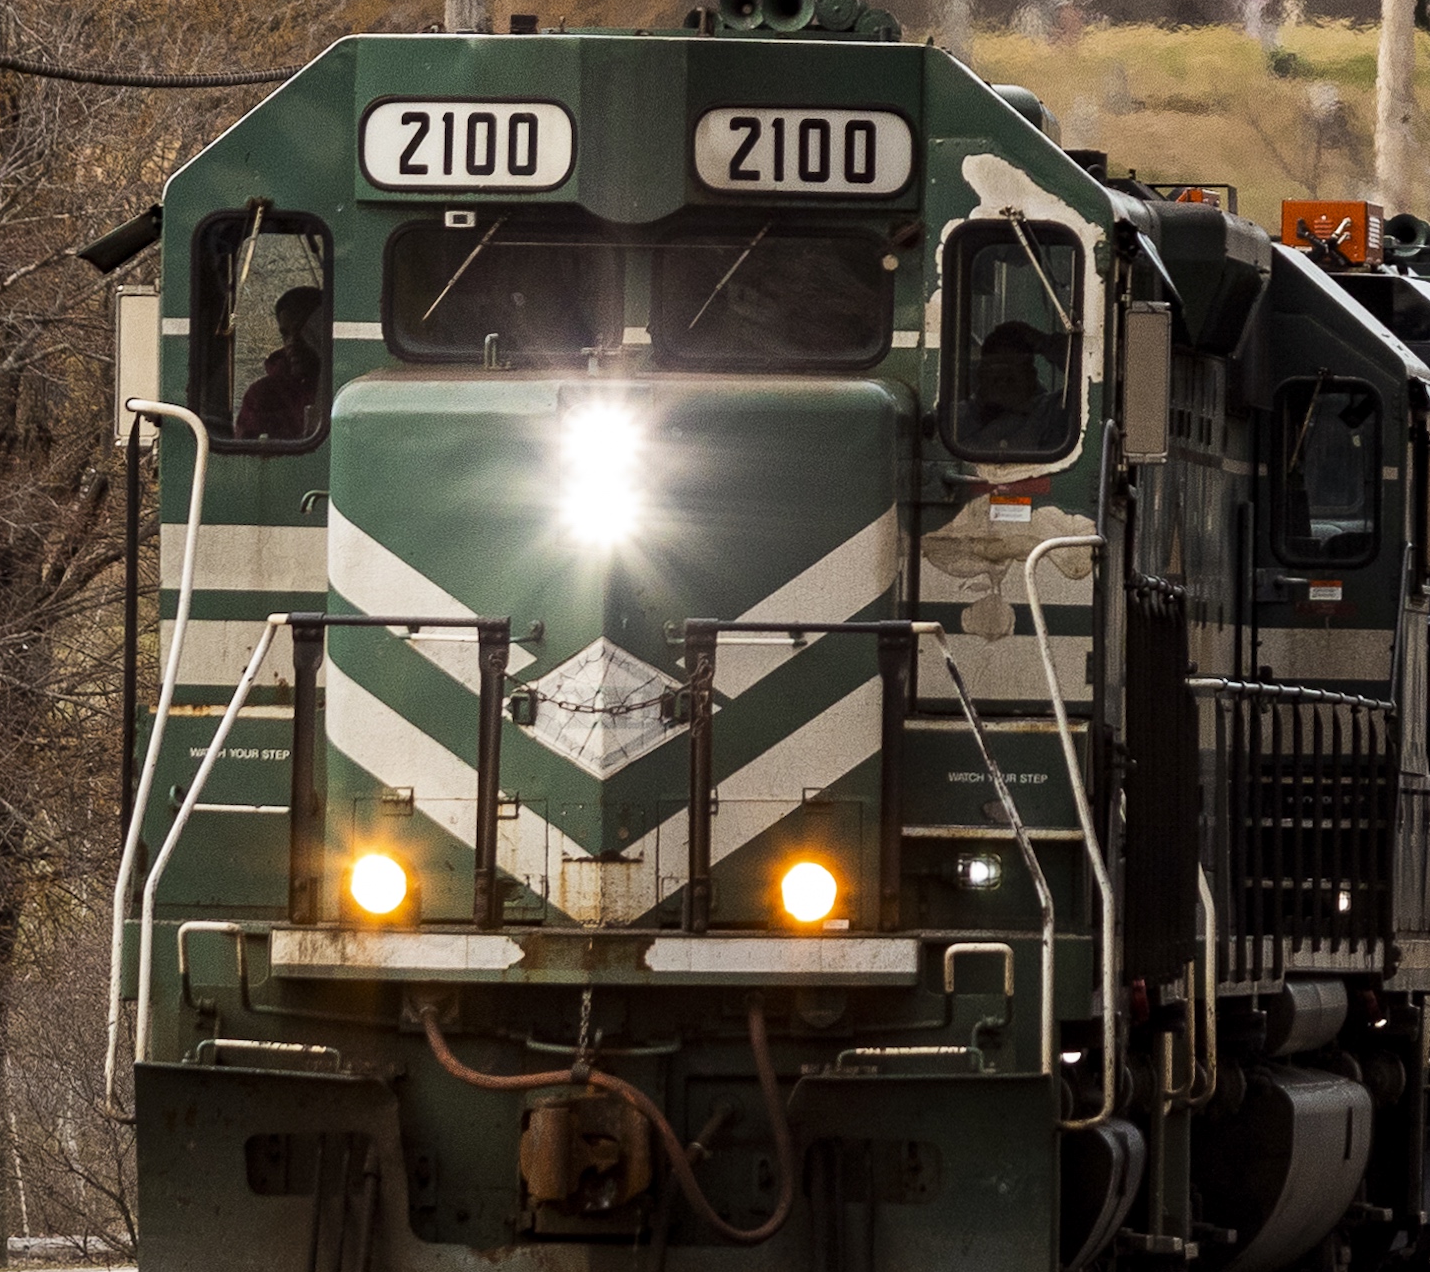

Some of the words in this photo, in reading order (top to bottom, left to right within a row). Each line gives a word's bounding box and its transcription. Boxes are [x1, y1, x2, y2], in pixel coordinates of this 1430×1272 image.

[399, 111, 539, 176] 2100
[728, 116, 877, 183] 2100
[229, 748, 259, 759] YOUR
[260, 749, 291, 761] STEP
[948, 771, 985, 783] WATCH
[1019, 773, 1049, 784] STEP
